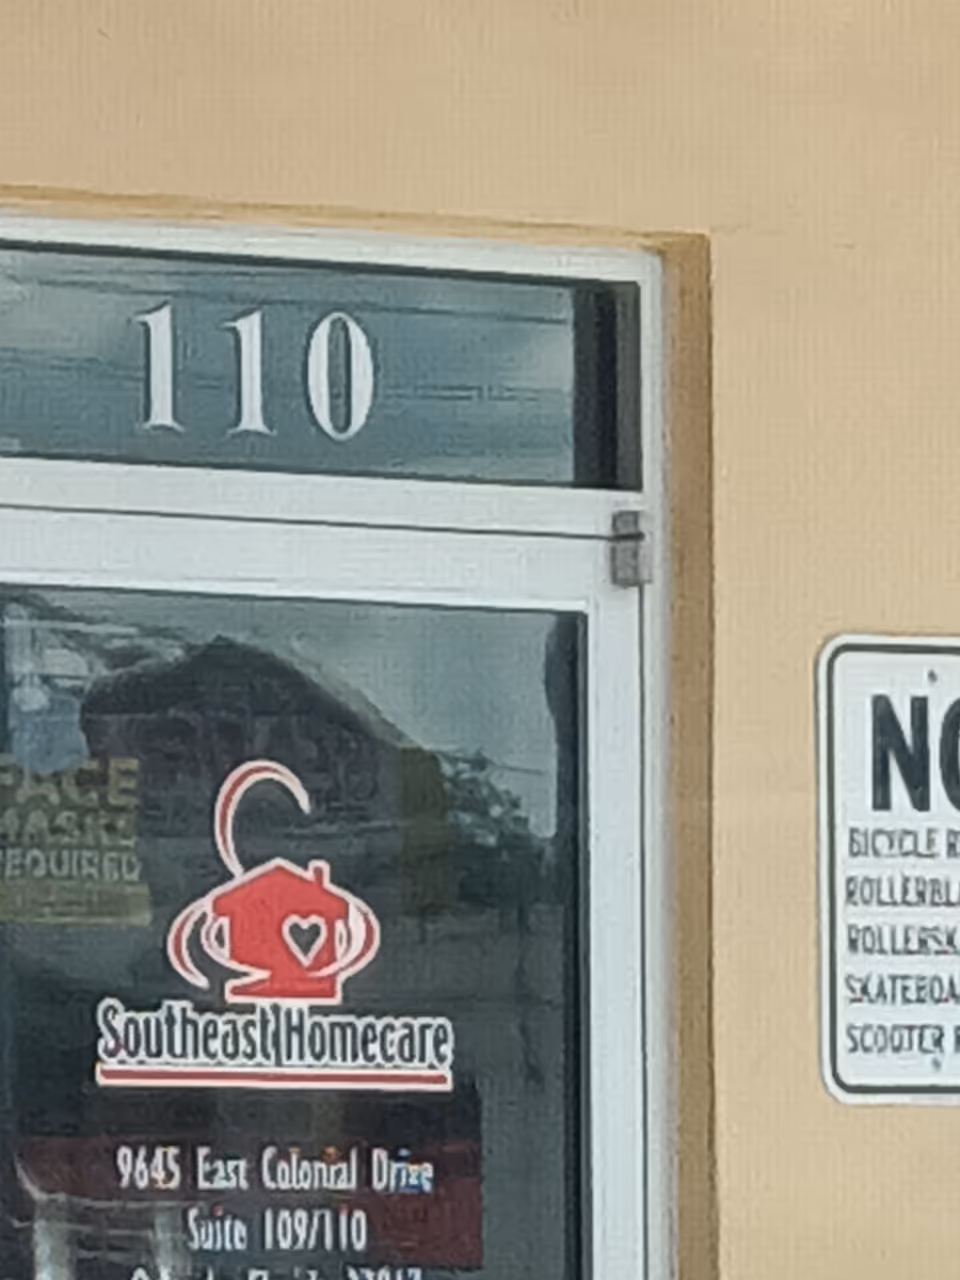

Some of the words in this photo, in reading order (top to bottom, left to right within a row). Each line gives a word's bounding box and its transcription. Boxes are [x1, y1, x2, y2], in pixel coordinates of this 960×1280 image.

[134, 302, 375, 441] 110
[848, 827, 940, 859] BICYCLE
[845, 874, 960, 907] ROLLERBL
[847, 924, 960, 956] ROLLERSK
[845, 973, 960, 1004] SKATEBOA
[97, 998, 274, 1065] Southeast
[282, 1002, 454, 1069] Homecare
[846, 1023, 944, 1054] SCOOTER
[116, 1145, 181, 1190] 9645
[197, 1146, 248, 1191] East
[261, 1146, 357, 1190] Colonial
[371, 1147, 435, 1193] Drive
[187, 1205, 248, 1252] Suite
[264, 1207, 367, 1252] 109/110
